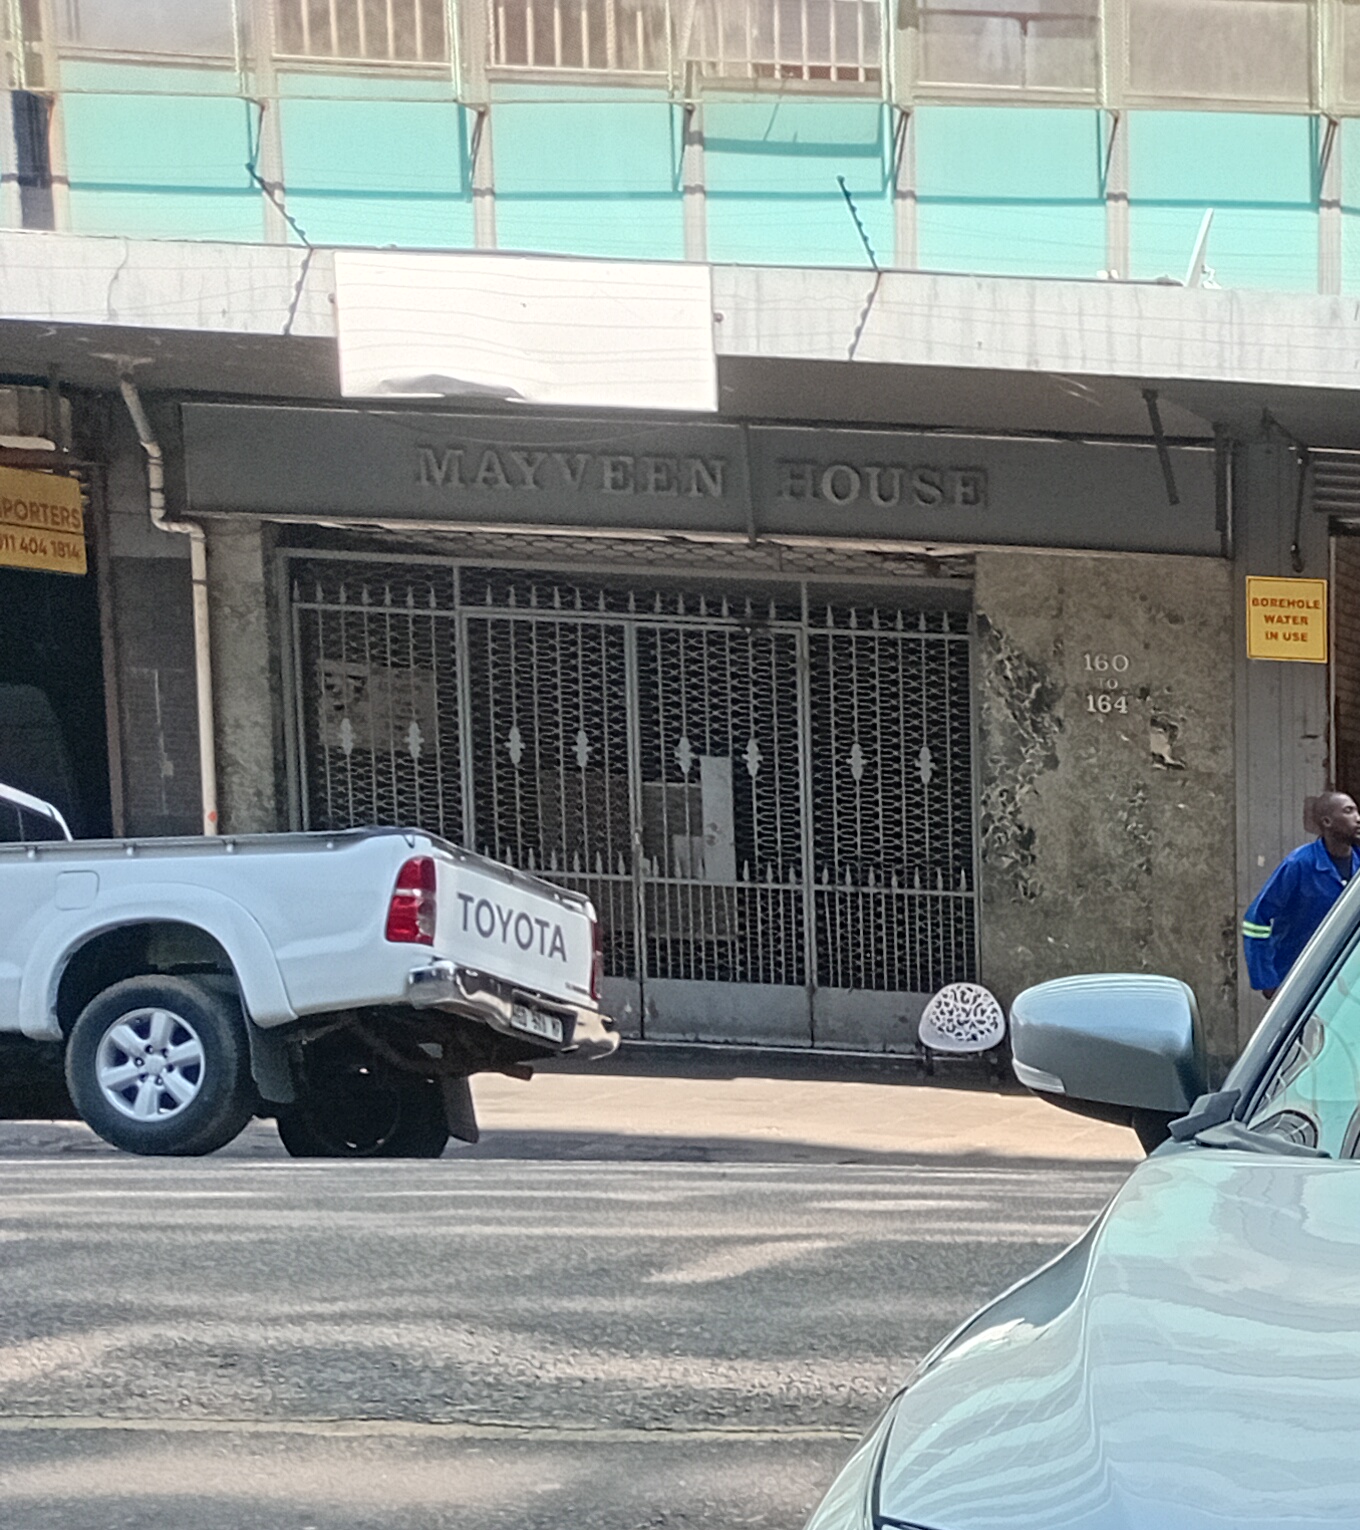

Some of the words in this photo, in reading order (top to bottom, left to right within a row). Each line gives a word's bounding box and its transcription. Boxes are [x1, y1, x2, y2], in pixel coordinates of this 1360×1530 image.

[415, 446, 727, 499] MAYVEEN
[778, 459, 988, 508] HOUSE
[0, 497, 81, 529] PORTERS
[21, 537, 47, 555] 404
[1252, 598, 1320, 610] BOREHOLE
[1264, 614, 1309, 626] WATER
[1265, 631, 1279, 642] IN
[1283, 631, 1308, 642] USE
[1084, 653, 1129, 673] 160
[1086, 694, 1128, 714] 164
[457, 892, 567, 963] TOYOTA
